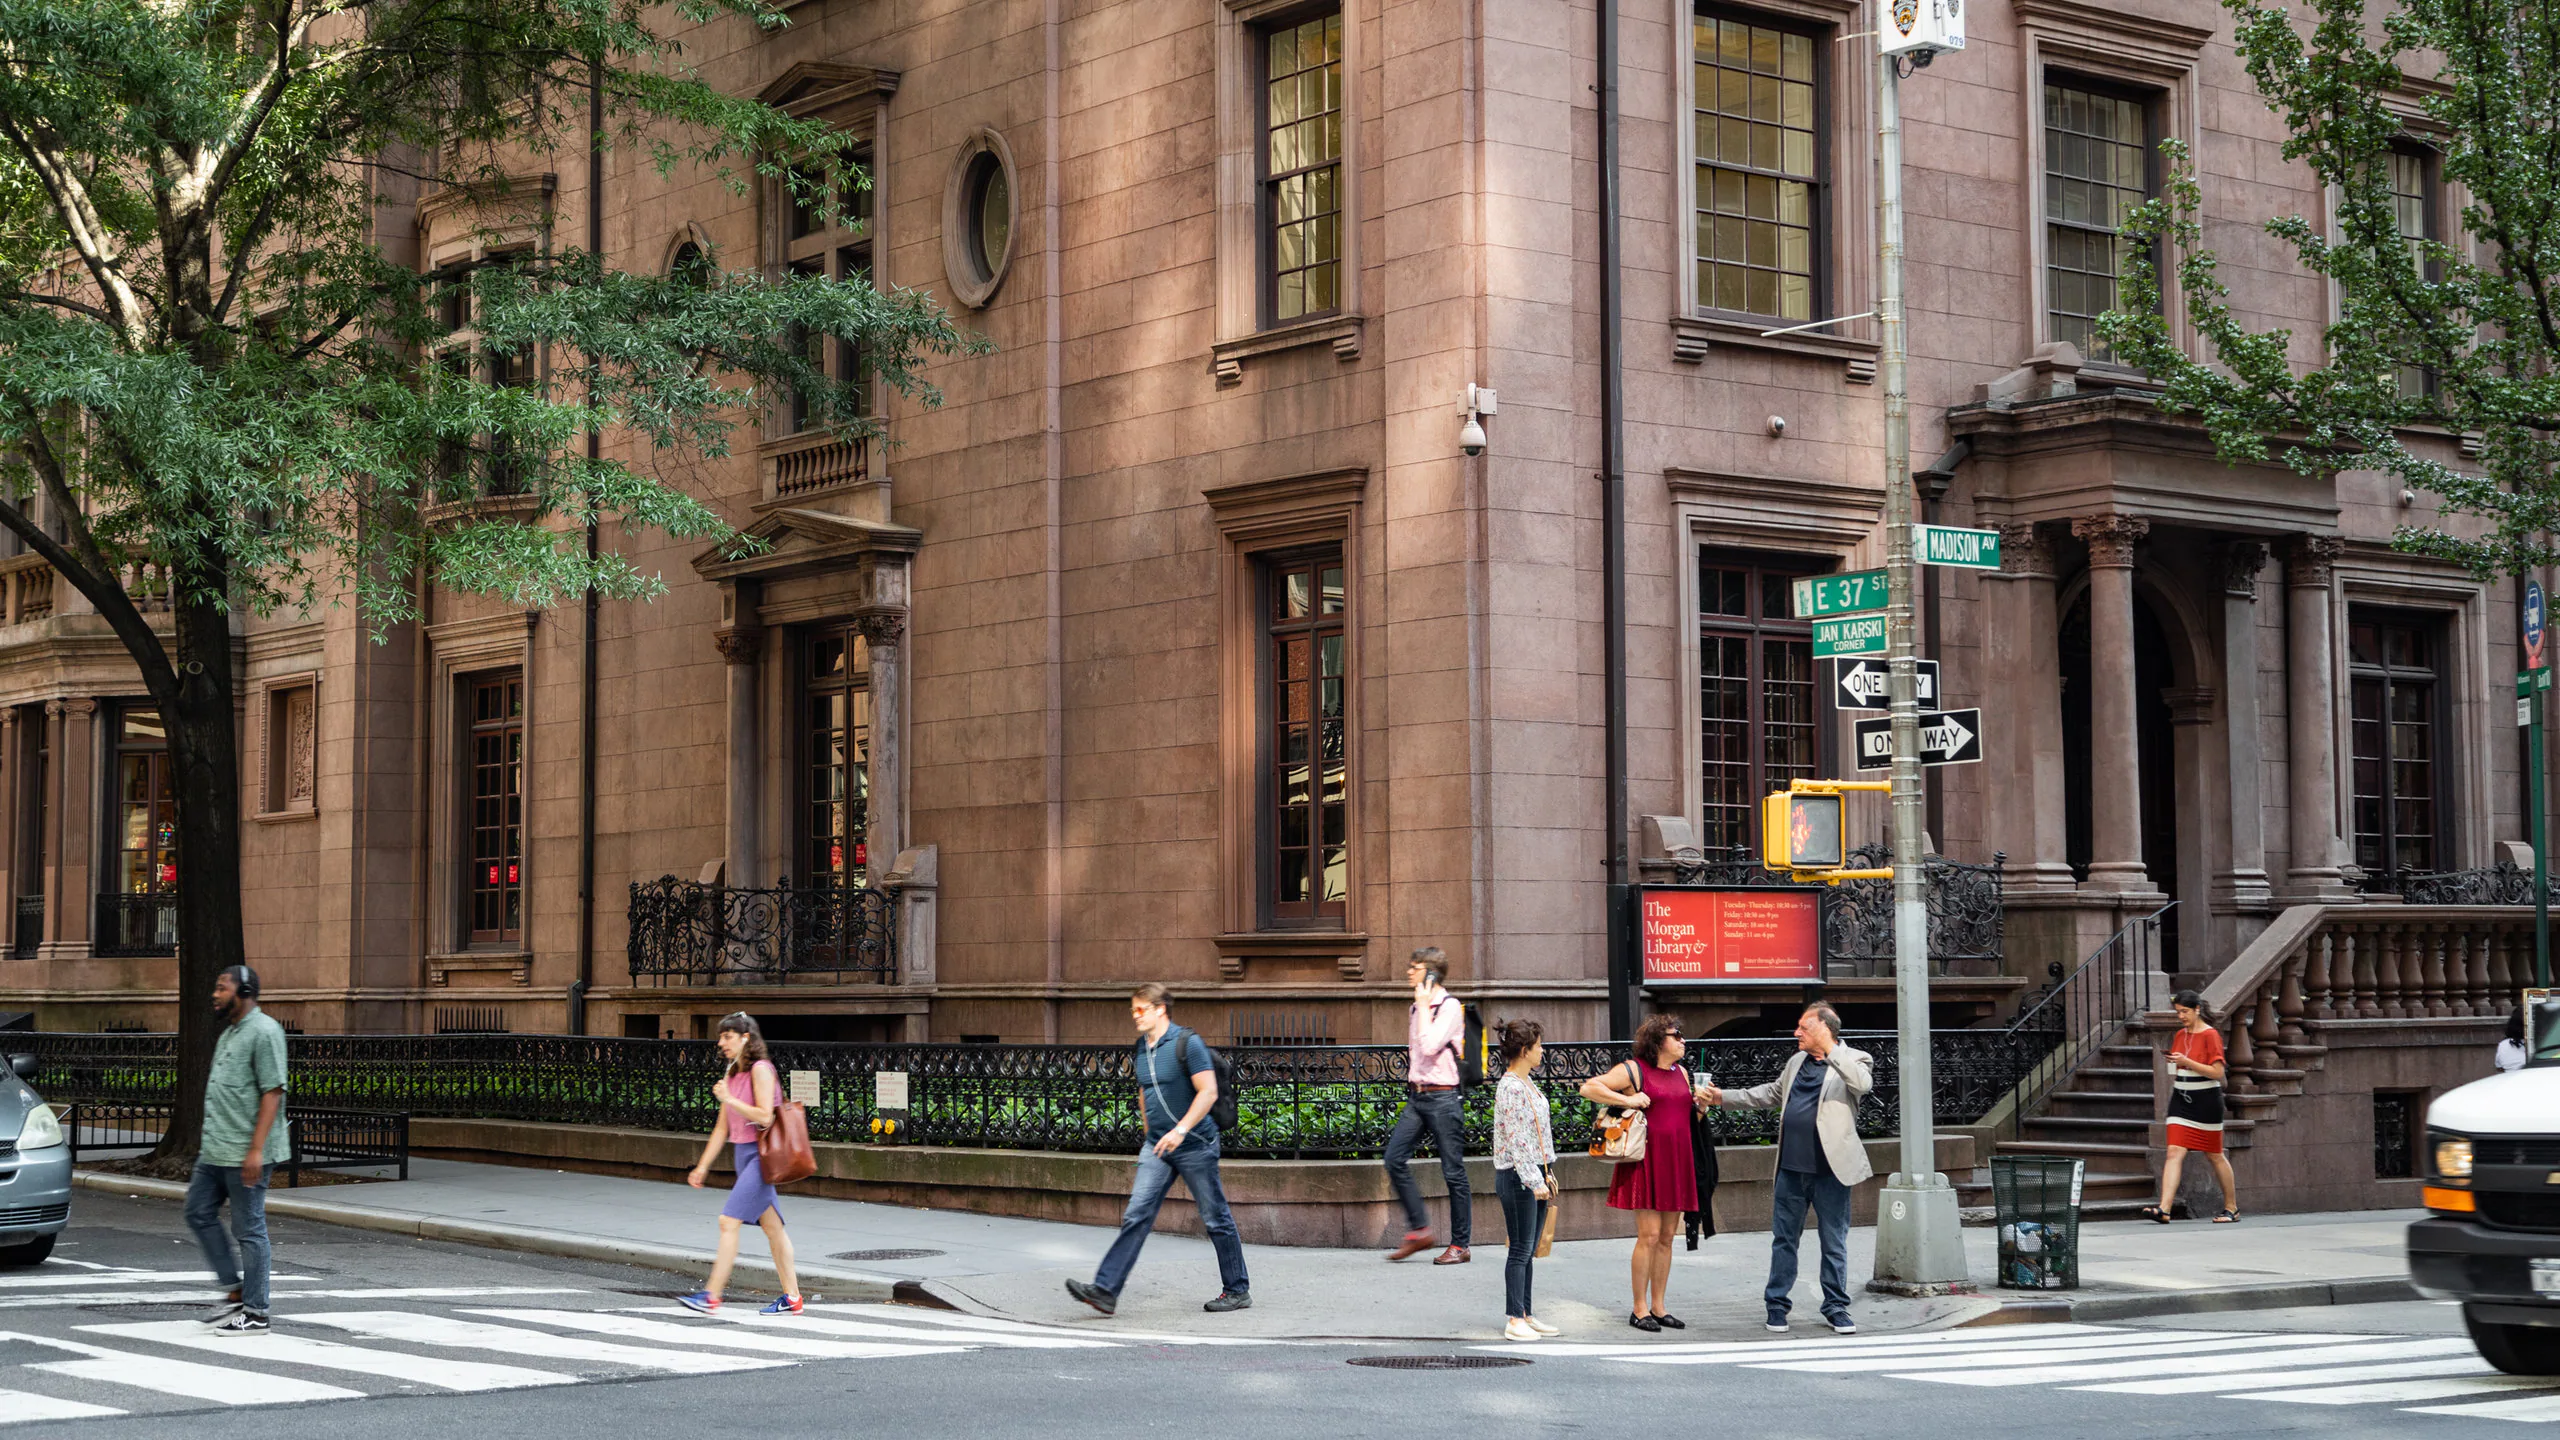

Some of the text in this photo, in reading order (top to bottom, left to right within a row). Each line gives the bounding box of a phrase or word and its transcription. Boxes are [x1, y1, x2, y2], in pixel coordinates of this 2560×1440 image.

[1949, 35, 1964, 47] 079
[1930, 531, 1996, 562] MADISON AV
[1816, 574, 1888, 611] E 37 ST
[1817, 619, 1882, 643] JAN KARSKI
[1833, 639, 1866, 652] CORNER
[1853, 674, 1881, 694] ONE
[1874, 727, 1961, 753] ON WAY
[1645, 901, 1671, 917] The
[1723, 911, 1743, 919] Friday:
[1647, 920, 1695, 940] Morgan
[1723, 920, 1749, 930] Saturday:
[1723, 930, 1745, 940] Sunday:
[1647, 938, 1693, 959] Library
[1648, 957, 1702, 973] Museum
